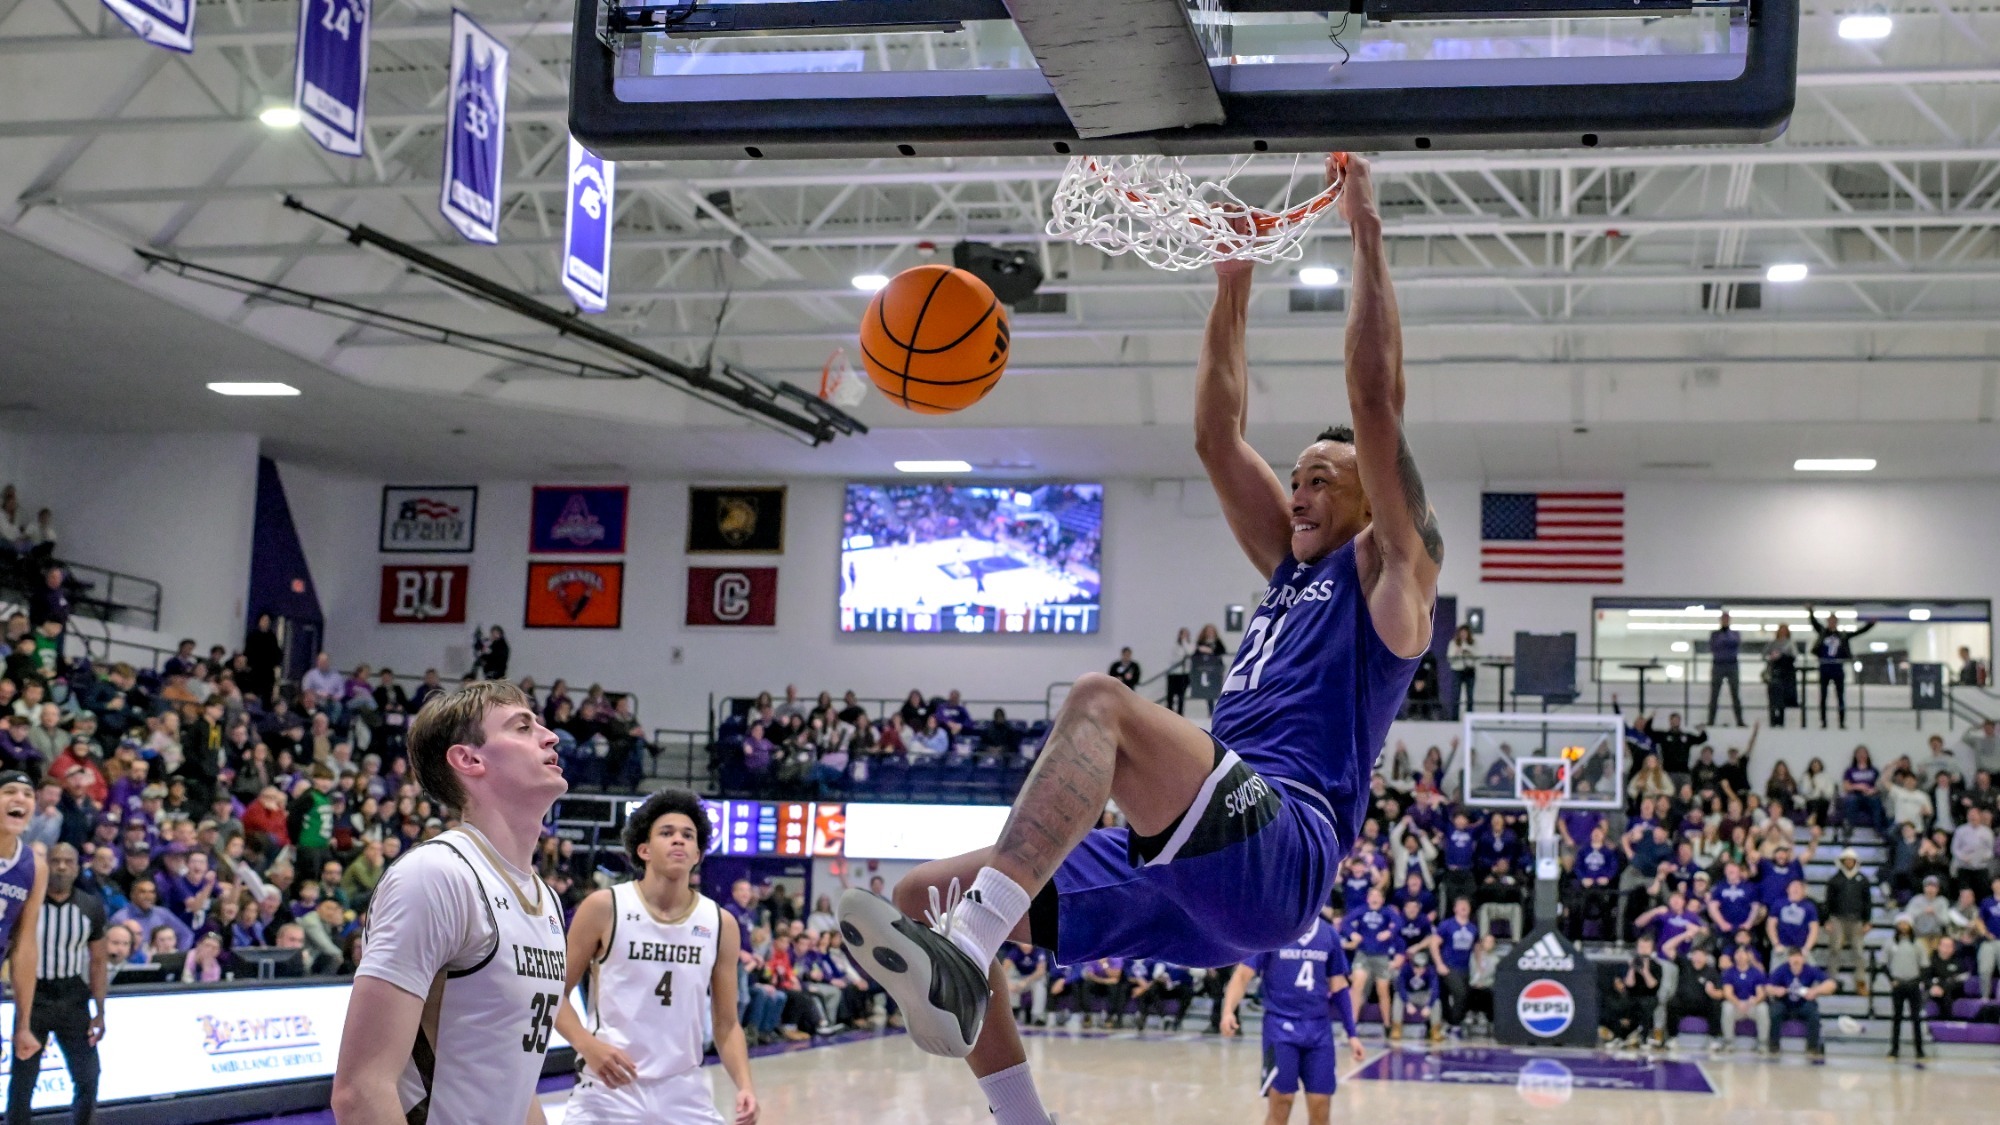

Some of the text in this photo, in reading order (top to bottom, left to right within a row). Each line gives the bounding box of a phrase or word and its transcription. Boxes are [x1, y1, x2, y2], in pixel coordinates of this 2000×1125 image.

[320, 0, 351, 41] 24
[464, 101, 489, 139] 33
[393, 570, 455, 619] BU
[713, 572, 751, 621] C
[1221, 612, 1288, 692] 21
[512, 944, 565, 982] LEHIGH
[628, 941, 703, 965] LEHIGH
[1302, 949, 1329, 962] CROSS
[1517, 953, 1575, 971] adidas
[655, 970, 673, 1007] 4
[1294, 960, 1315, 991] 4
[521, 992, 559, 1055] 35
[1521, 1002, 1570, 1014] PEPSI
